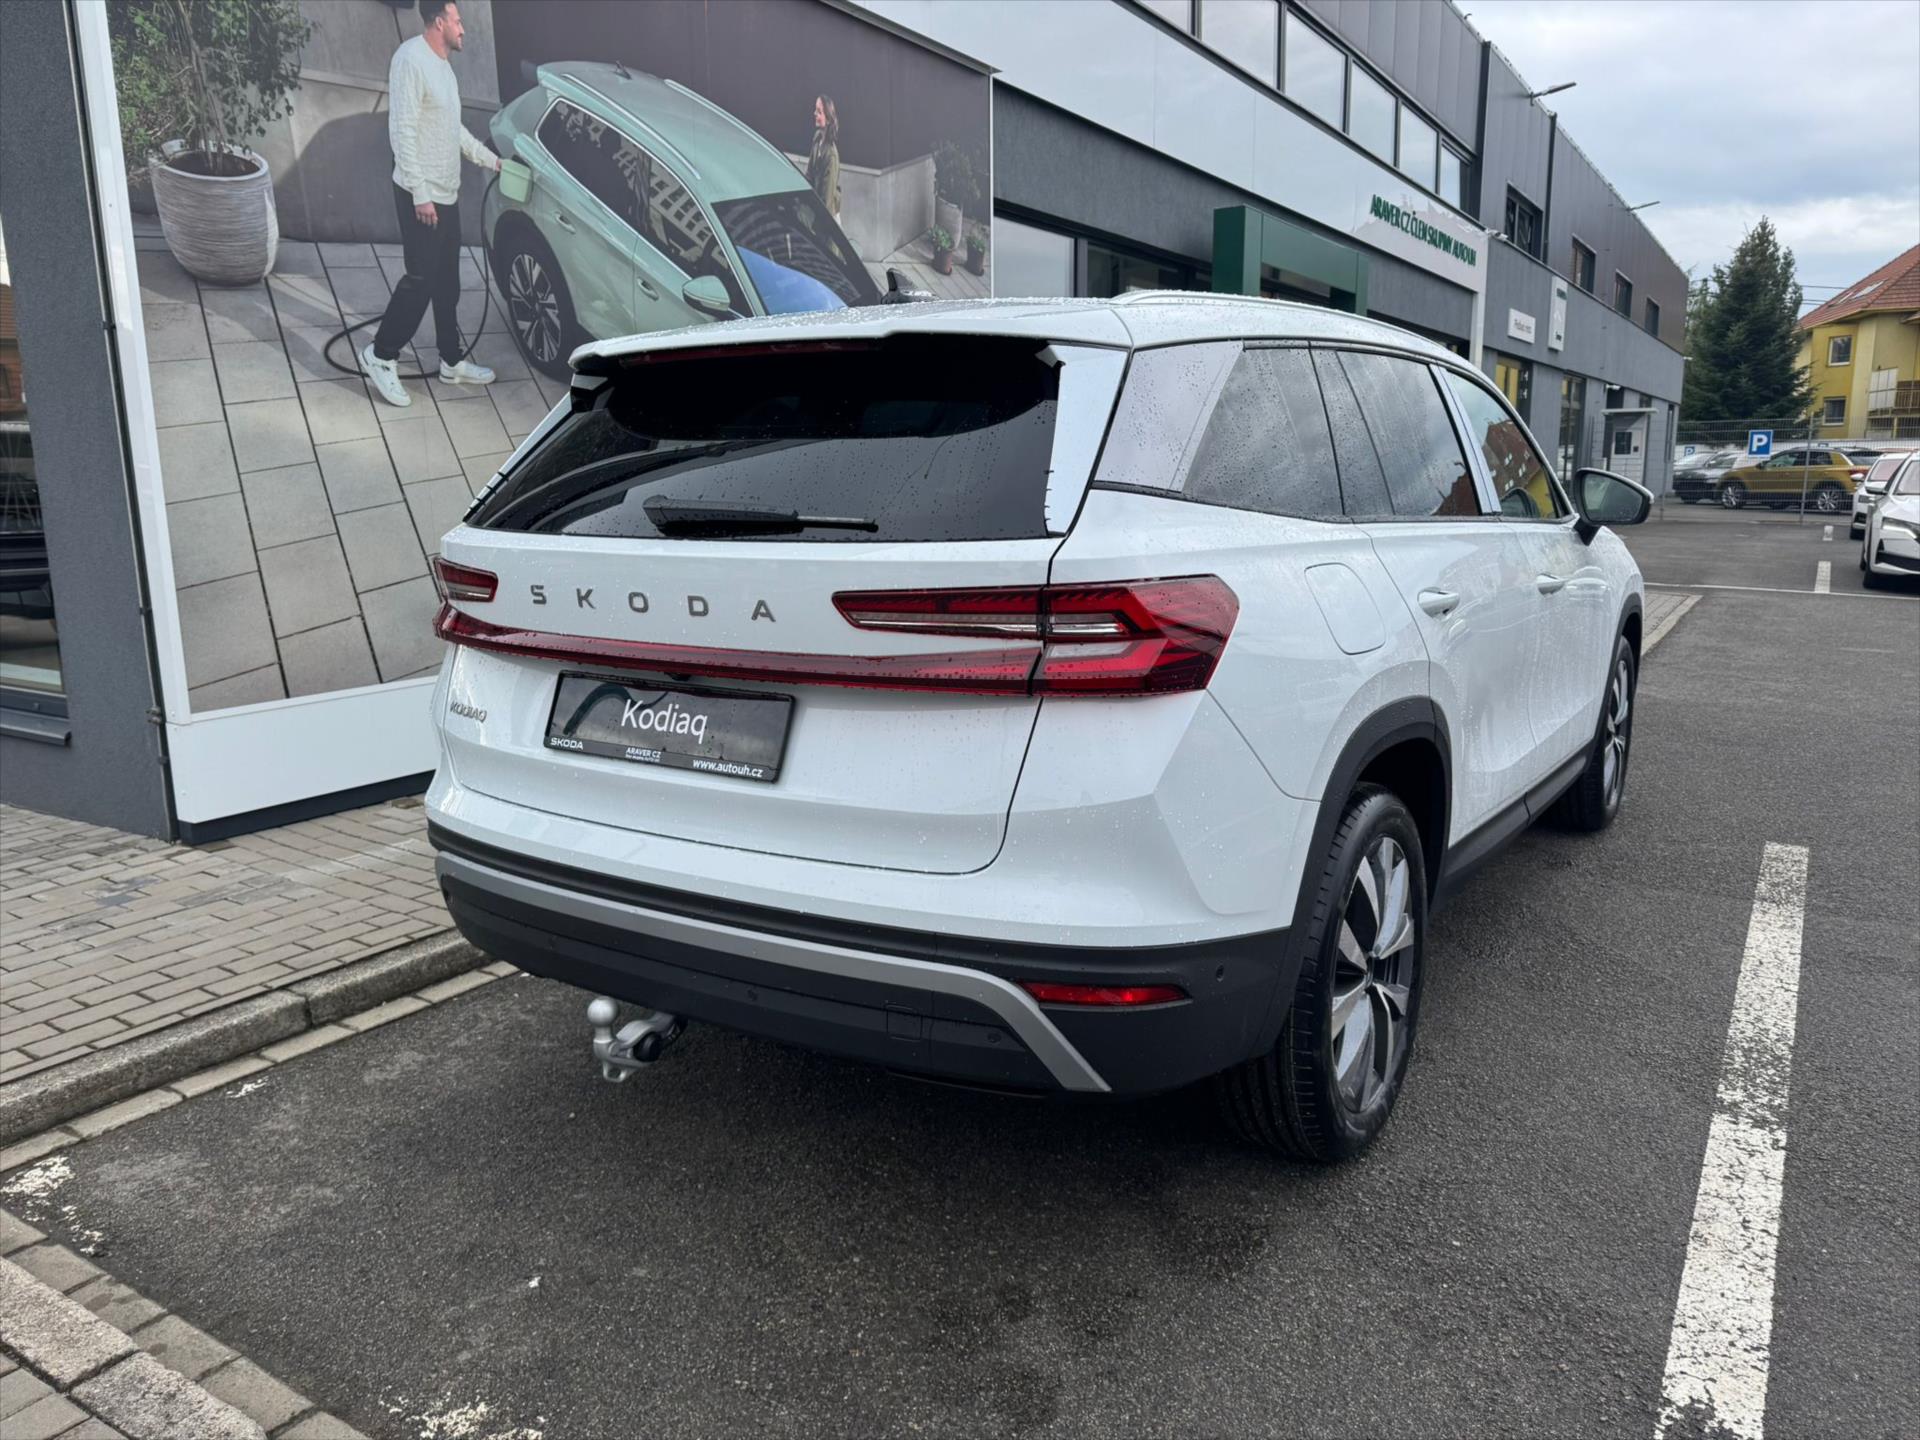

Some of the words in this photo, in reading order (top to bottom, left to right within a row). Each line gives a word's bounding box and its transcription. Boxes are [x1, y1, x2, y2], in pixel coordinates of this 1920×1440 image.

[1370, 194, 1400, 228] ARAVER
[1400, 211, 1411, 234] CZ
[1752, 434, 1768, 451] P
[449, 697, 488, 723] KODIAQ
[621, 698, 708, 744] Kodiaq
[625, 747, 652, 757] ARAVER
[692, 758, 764, 779] www.autouh.cz
